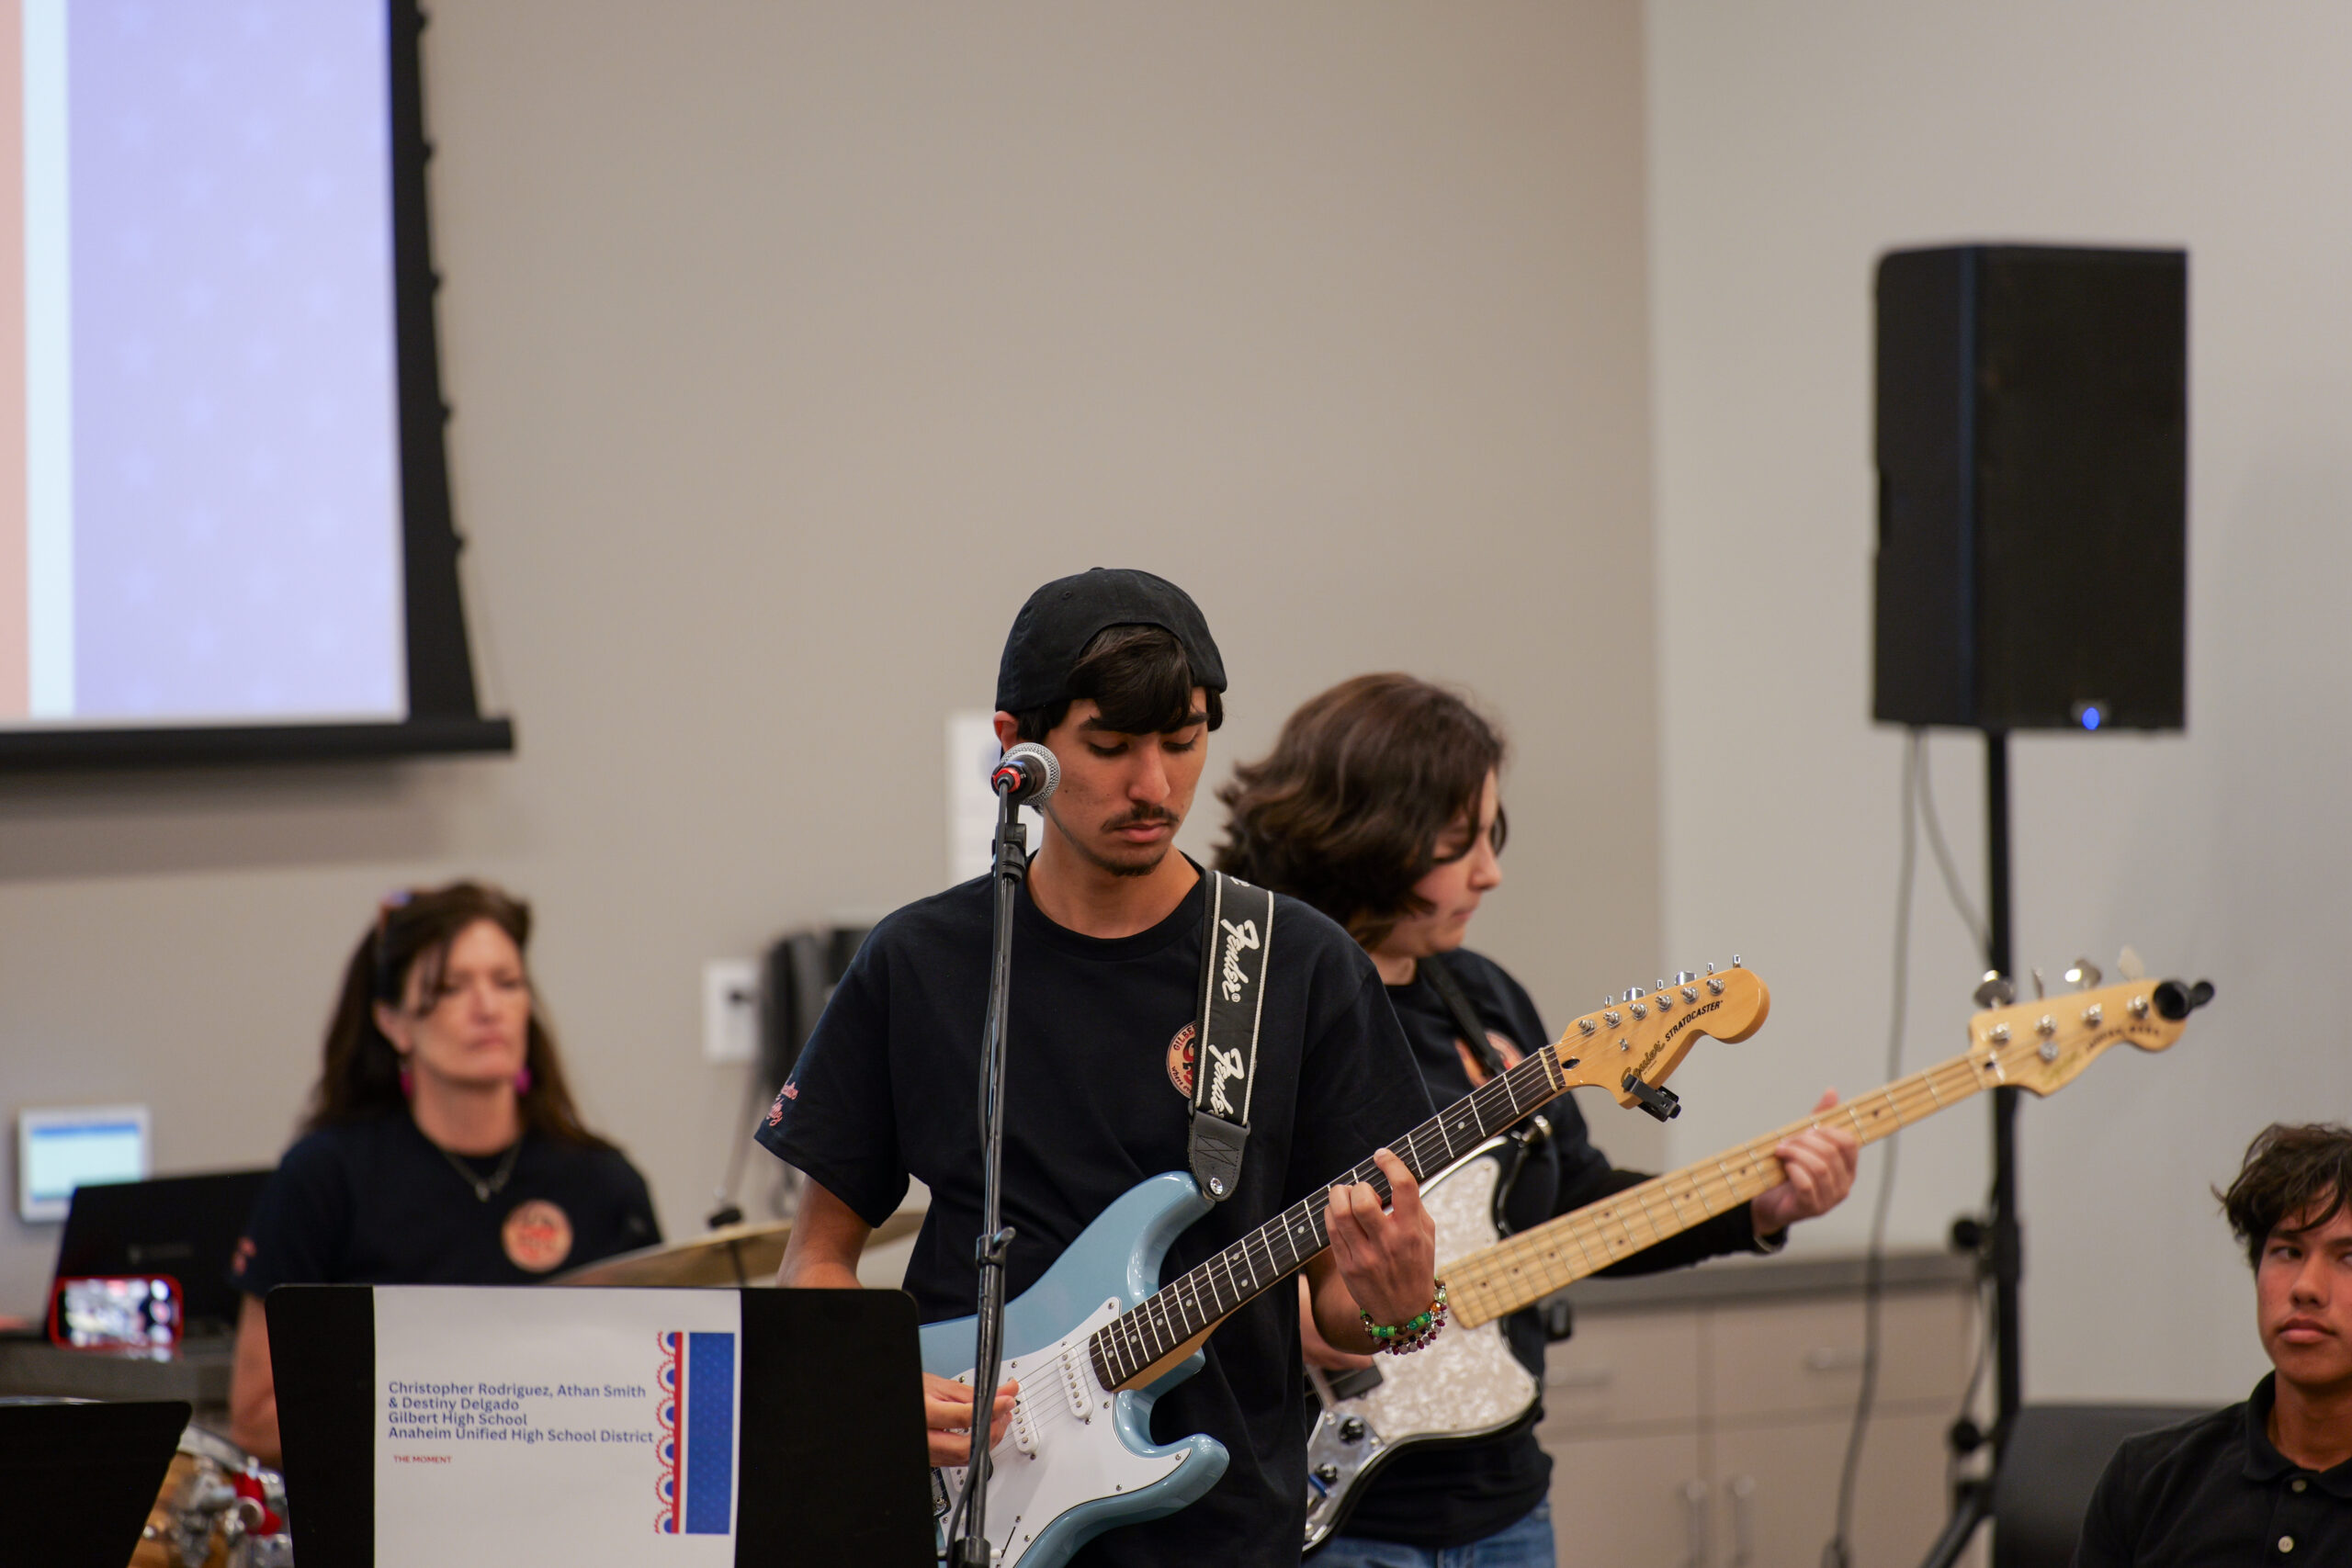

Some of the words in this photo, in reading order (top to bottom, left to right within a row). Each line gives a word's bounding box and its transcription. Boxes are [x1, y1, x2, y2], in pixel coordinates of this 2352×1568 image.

[1665, 1000, 1721, 1042] STRATOCASTER
[389, 1382, 473, 1396] Christopher
[479, 1383, 553, 1398] Rodriguez,
[557, 1384, 599, 1397] Athan
[604, 1385, 646, 1398] Smith
[389, 1398, 399, 1409] &
[402, 1398, 456, 1412] Destiny
[461, 1399, 519, 1414] Delgado
[389, 1412, 437, 1424] Gilbert
[443, 1413, 474, 1427] High
[479, 1414, 527, 1426] School
[389, 1427, 451, 1439] Anaheim
[456, 1427, 507, 1440] Unified
[511, 1429, 543, 1444] High
[548, 1430, 596, 1442] School
[601, 1430, 653, 1443] District
[393, 1455, 411, 1463] THE
[413, 1455, 452, 1463] MOMENT
